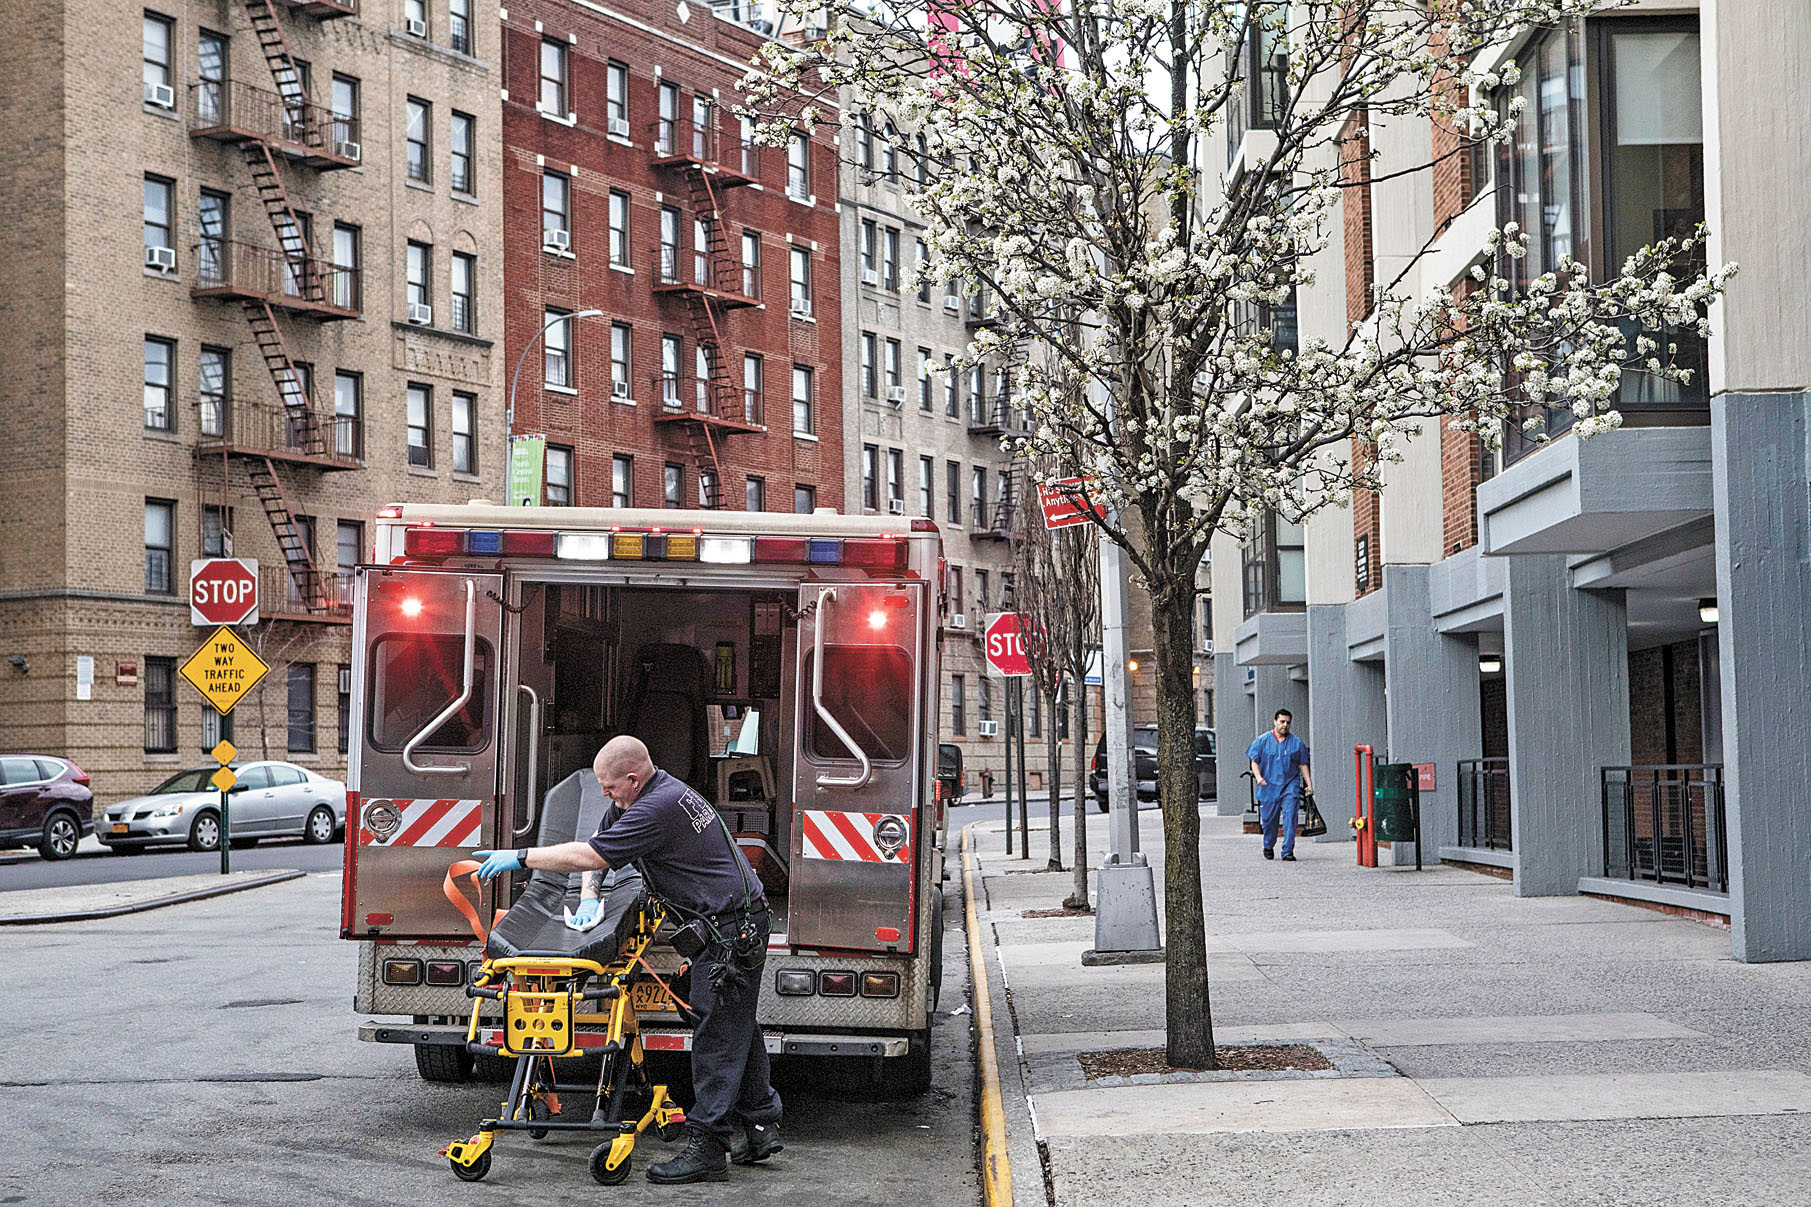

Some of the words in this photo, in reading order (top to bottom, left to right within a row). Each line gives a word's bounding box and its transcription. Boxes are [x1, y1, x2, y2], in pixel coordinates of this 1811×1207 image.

[1046, 494, 1078, 507] Anyti
[194, 579, 253, 604] STOP
[214, 643, 235, 653] TWO
[990, 632, 1040, 657] STO
[214, 657, 234, 666] WAY
[204, 669, 245, 679] TRAFFIC
[208, 682, 241, 693] AHEAD
